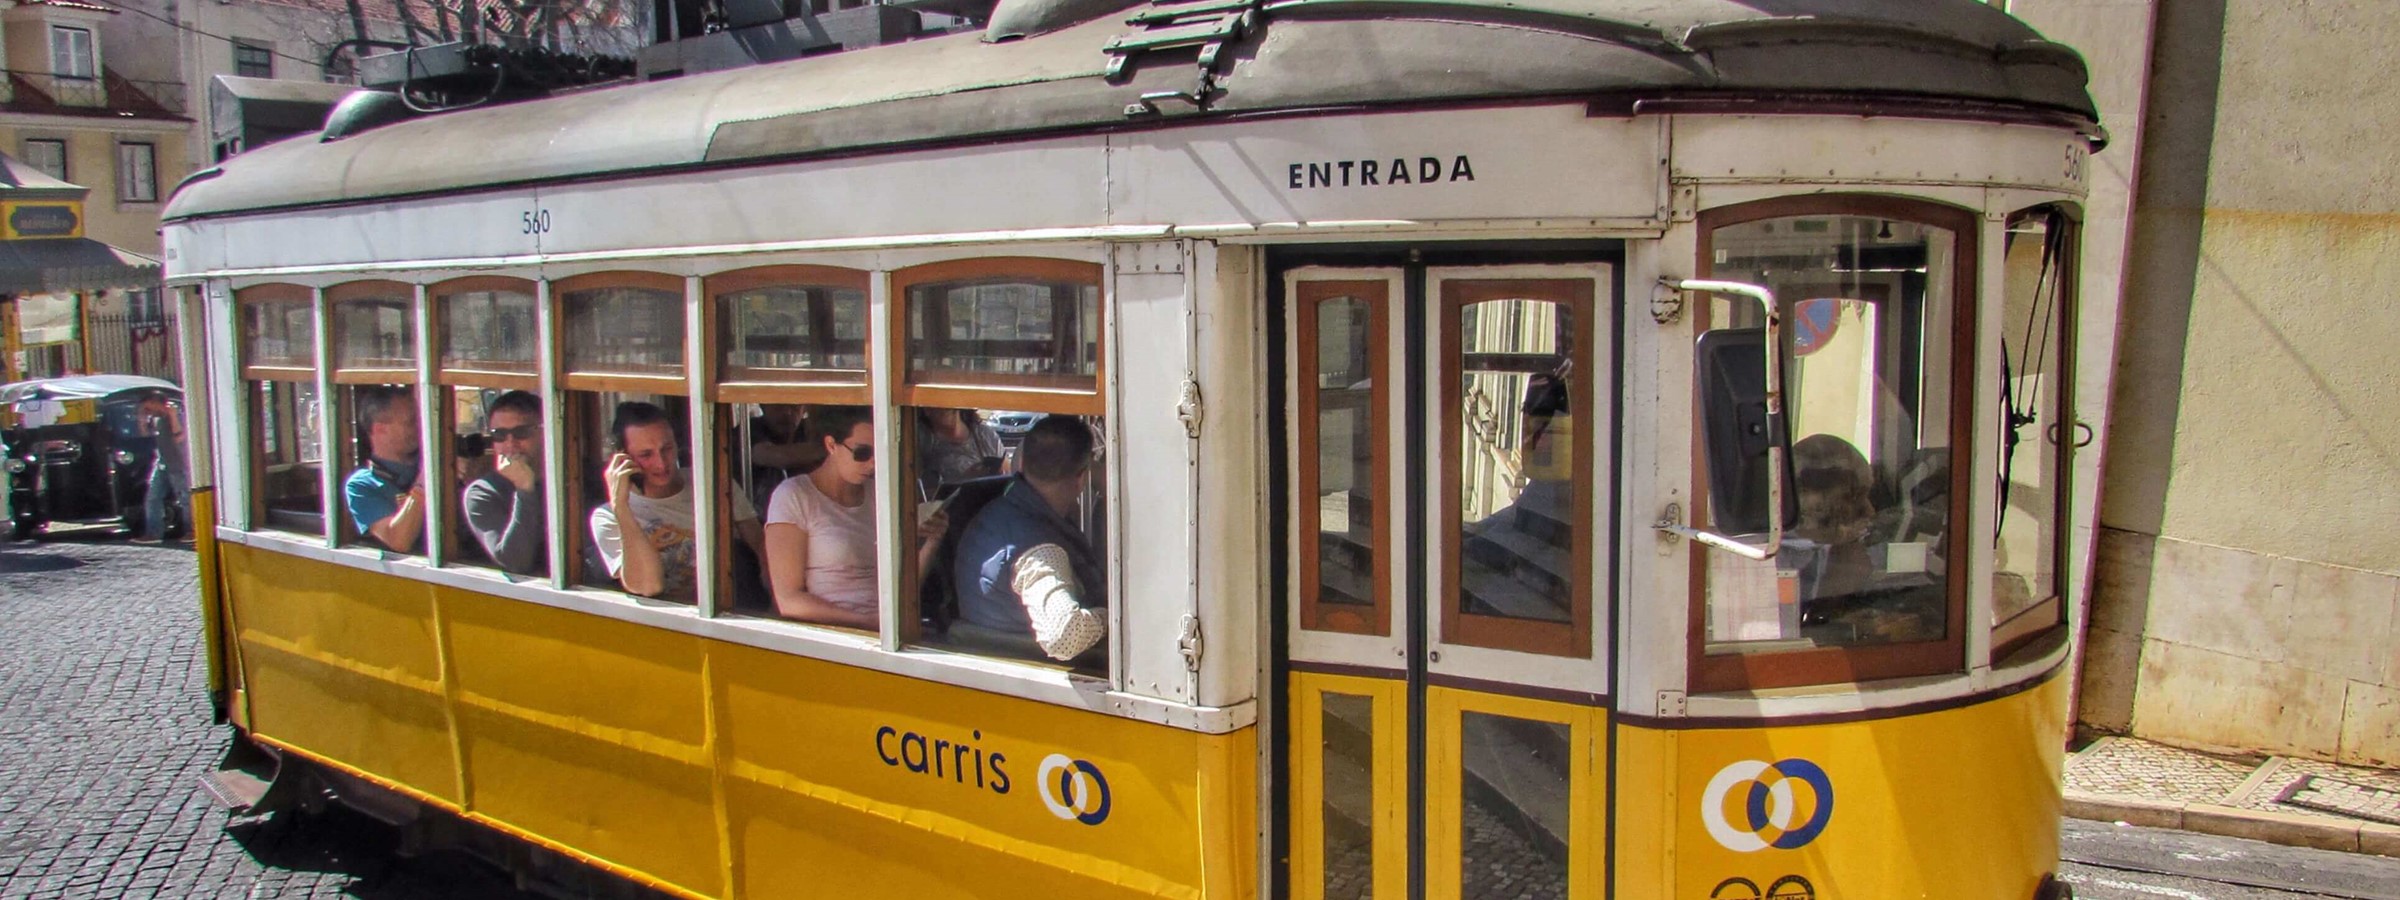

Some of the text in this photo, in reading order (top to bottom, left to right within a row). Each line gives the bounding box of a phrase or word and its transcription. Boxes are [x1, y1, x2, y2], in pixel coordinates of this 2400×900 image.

[1289, 155, 1475, 189] ENTRADA
[522, 209, 551, 235] 560
[876, 725, 1011, 794] carris
